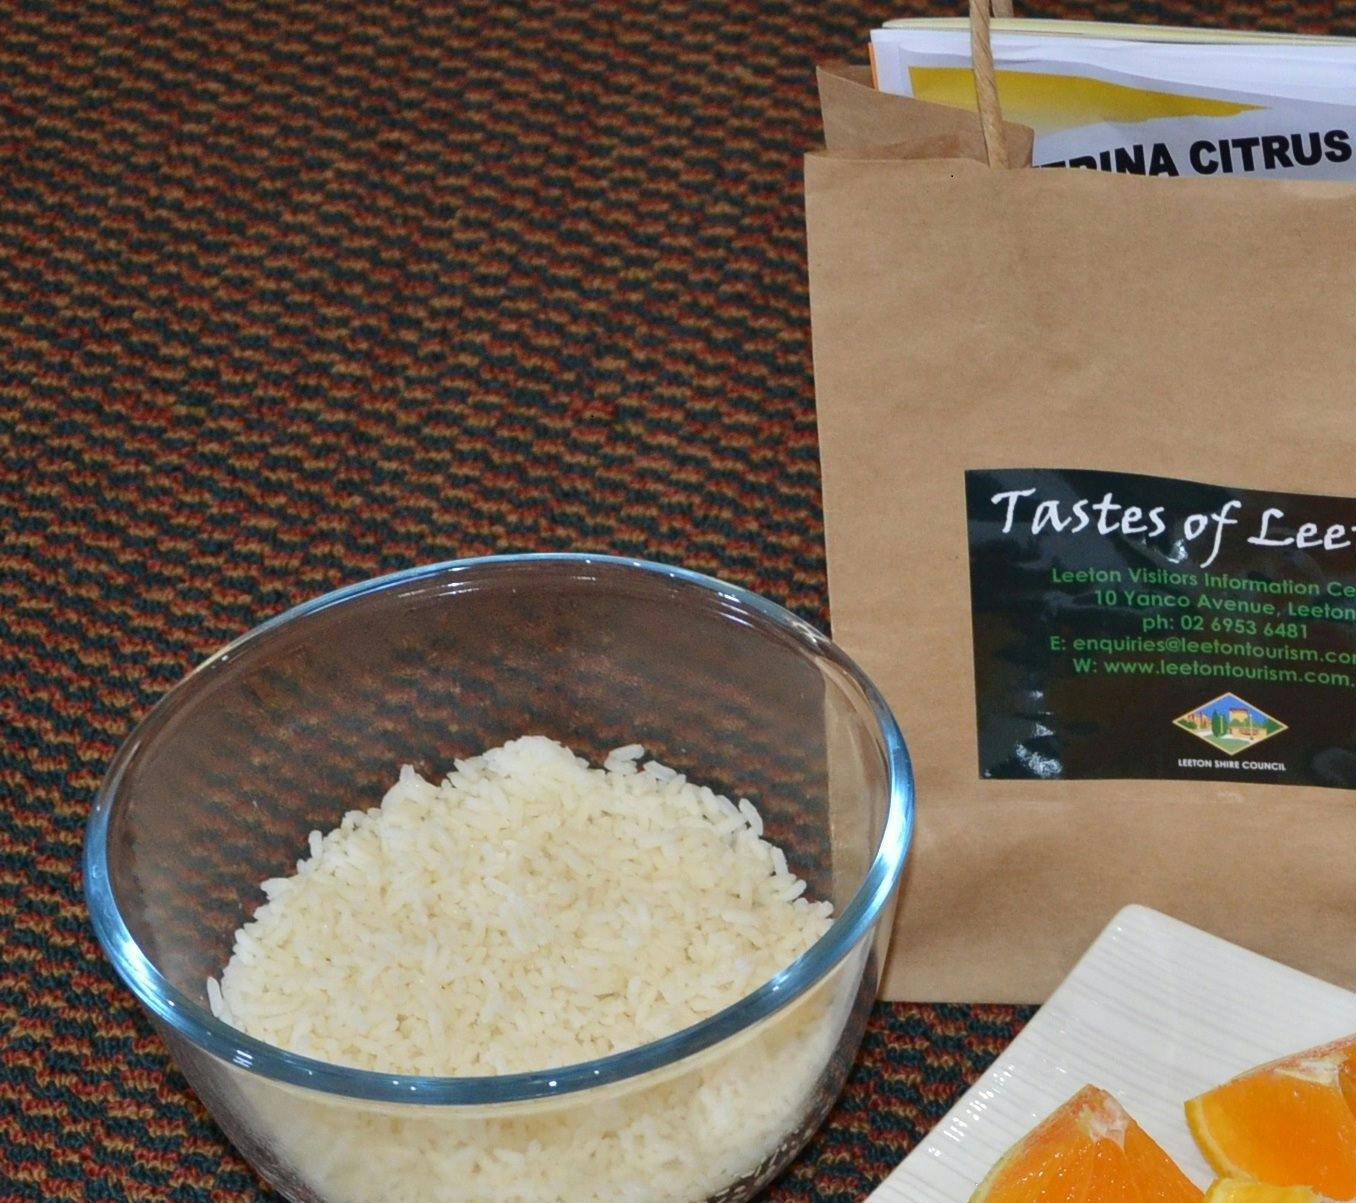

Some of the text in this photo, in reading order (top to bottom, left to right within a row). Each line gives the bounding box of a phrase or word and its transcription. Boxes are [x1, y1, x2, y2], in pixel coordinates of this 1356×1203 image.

[1189, 129, 1353, 175] CITRUS
[991, 487, 1167, 538] Tastes
[1184, 500, 1242, 568] of
[1052, 567, 1122, 584] Leeton
[1128, 567, 1198, 586] Visitors
[1205, 573, 1320, 595] Information
[1095, 590, 1356, 621] 10 Yanco Avenue, Leeton
[1142, 614, 1308, 639] ph: 02 6953 6481
[1050, 636, 1066, 651] E:
[1073, 658, 1097, 673] W:
[1177, 758, 1287, 771] LEETON SHIRE COUNCIL
